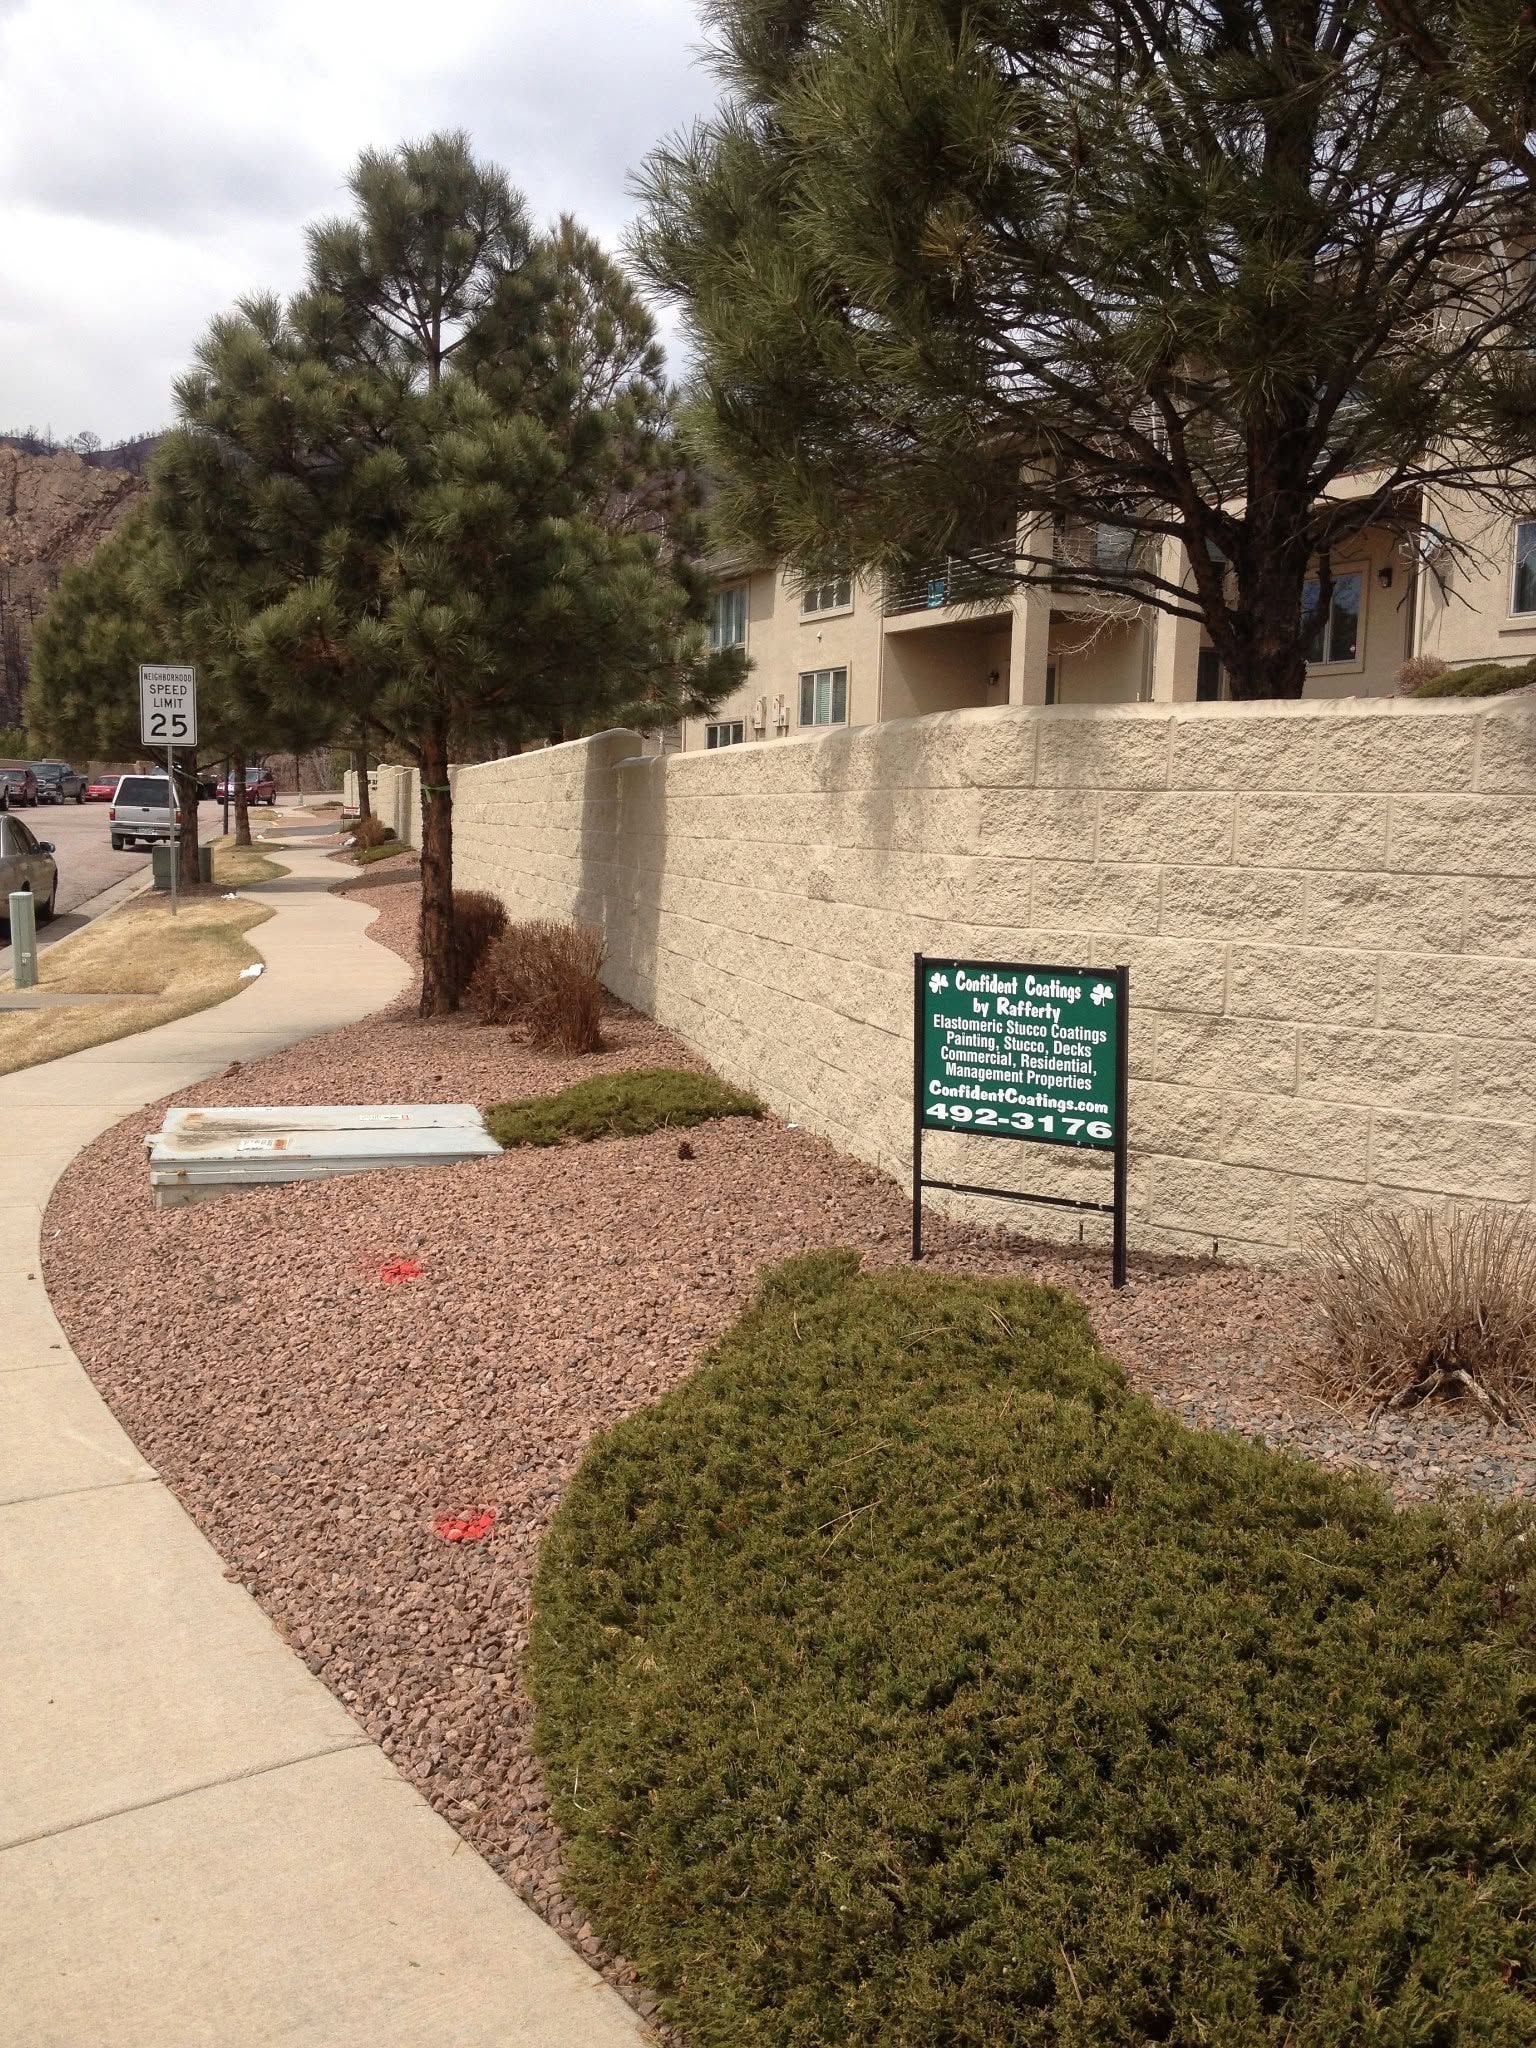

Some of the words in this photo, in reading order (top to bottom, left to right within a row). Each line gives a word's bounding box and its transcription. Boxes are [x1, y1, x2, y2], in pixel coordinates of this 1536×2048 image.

[143, 672, 192, 682] NEIGHBORHOOD
[149, 684, 187, 695] SPEED
[153, 698, 184, 709] LIMIT
[150, 713, 188, 738] 25
[955, 970, 1018, 995] Confident
[1024, 975, 1082, 1004] Coatings
[972, 998, 989, 1018] by
[996, 997, 1061, 1024] Rafferty
[933, 1014, 1003, 1034] Elastomeric
[1006, 1020, 1047, 1038] Stucco
[1051, 1024, 1107, 1045] Coatings
[946, 1031, 999, 1051] Painting,
[1003, 1037, 1049, 1056] Stucco,
[1053, 1041, 1092, 1058] Decks
[940, 1046, 1017, 1068] Commercial,
[1020, 1054, 1097, 1077] Residential,
[945, 1062, 1024, 1083] Management
[1026, 1070, 1092, 1091] Properties
[928, 1080, 1109, 1114] ConfidentCoatings.com
[926, 1103, 1113, 1139] 492-3176
